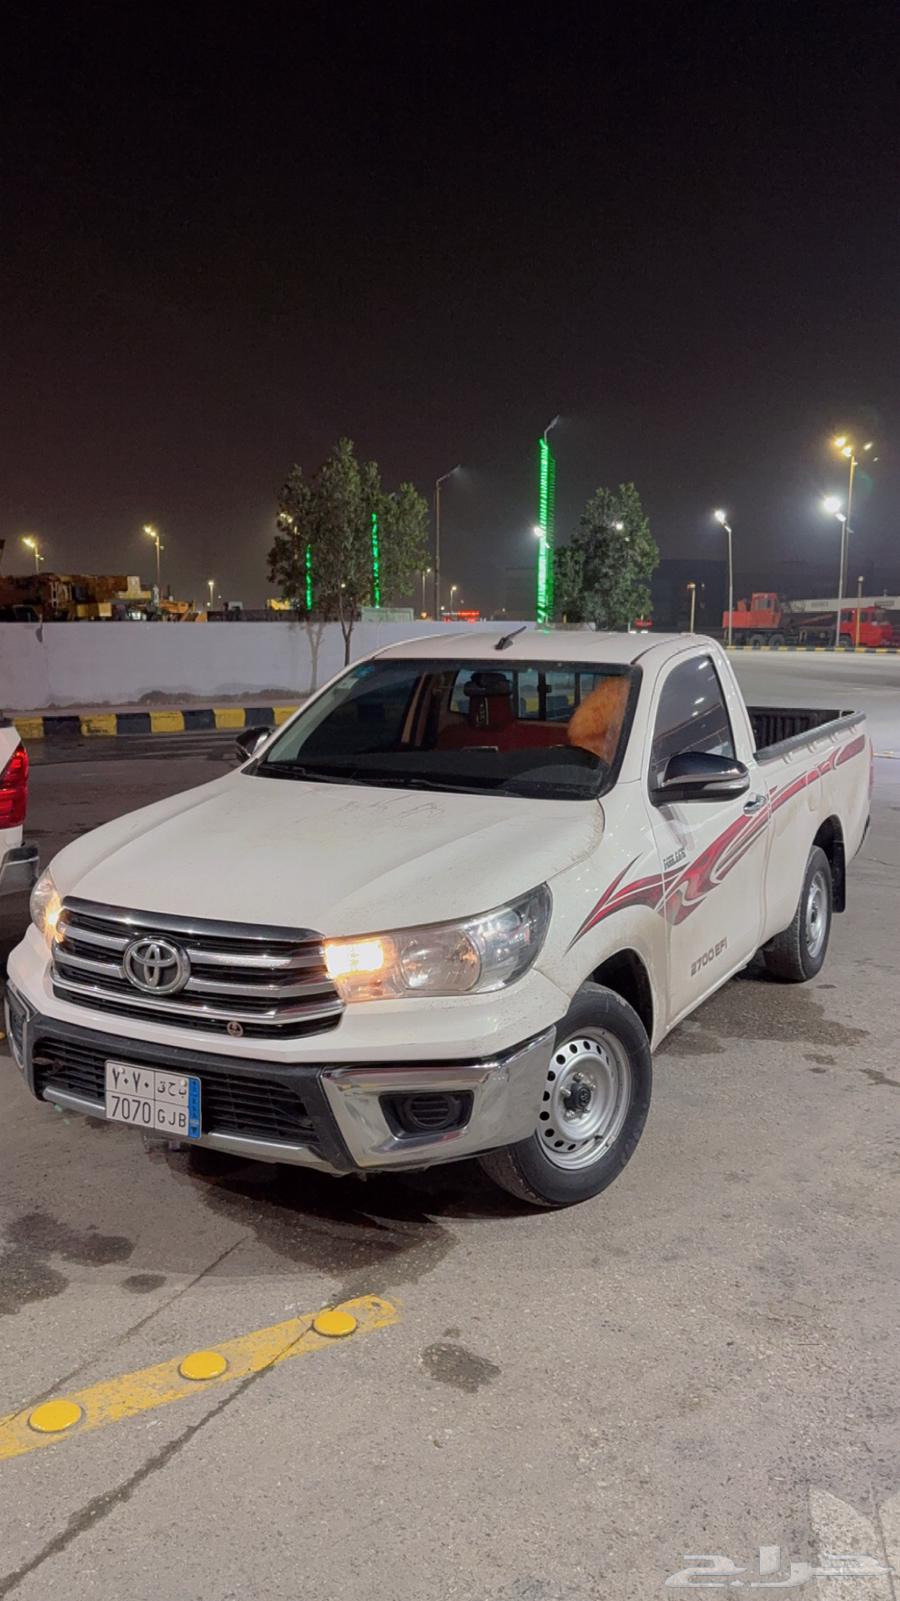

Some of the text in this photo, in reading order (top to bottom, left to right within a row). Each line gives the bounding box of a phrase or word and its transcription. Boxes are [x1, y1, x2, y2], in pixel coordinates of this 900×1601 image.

[690, 948, 714, 977] 2700
[111, 1095, 187, 1128] 7070 GJB
